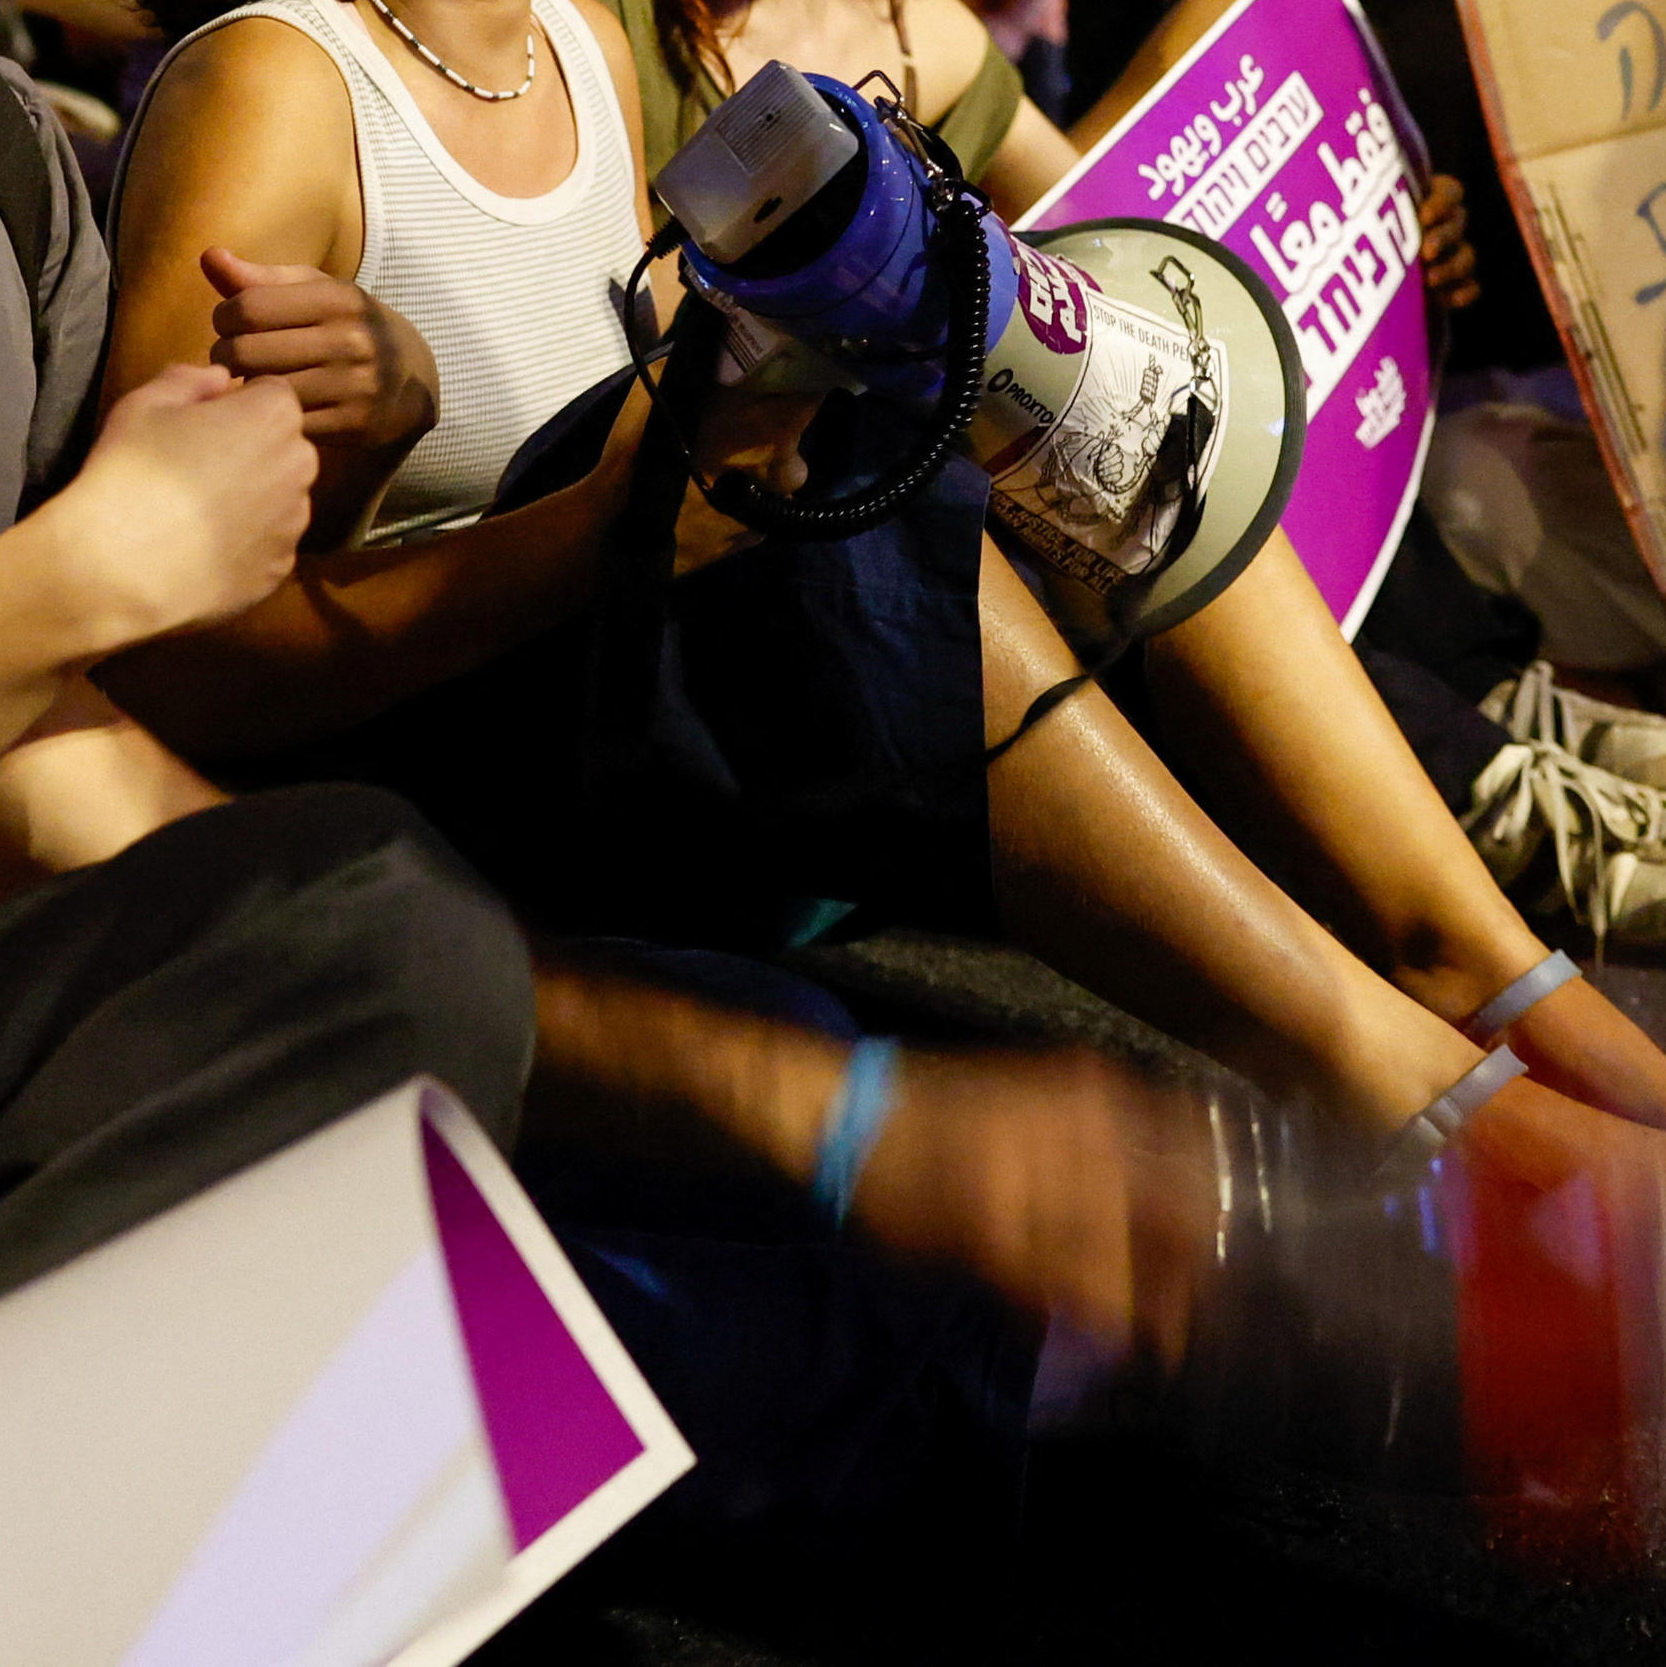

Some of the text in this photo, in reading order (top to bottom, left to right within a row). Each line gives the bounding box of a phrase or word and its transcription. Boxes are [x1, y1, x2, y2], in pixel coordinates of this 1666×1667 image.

[1137, 52, 1265, 201] عرب ويهود
[1246, 84, 1314, 172] ערבים
[1316, 86, 1404, 222] فقط
[1093, 304, 1191, 362] STOP THE DEATH PE
[1296, 230, 1390, 354] ביחד
